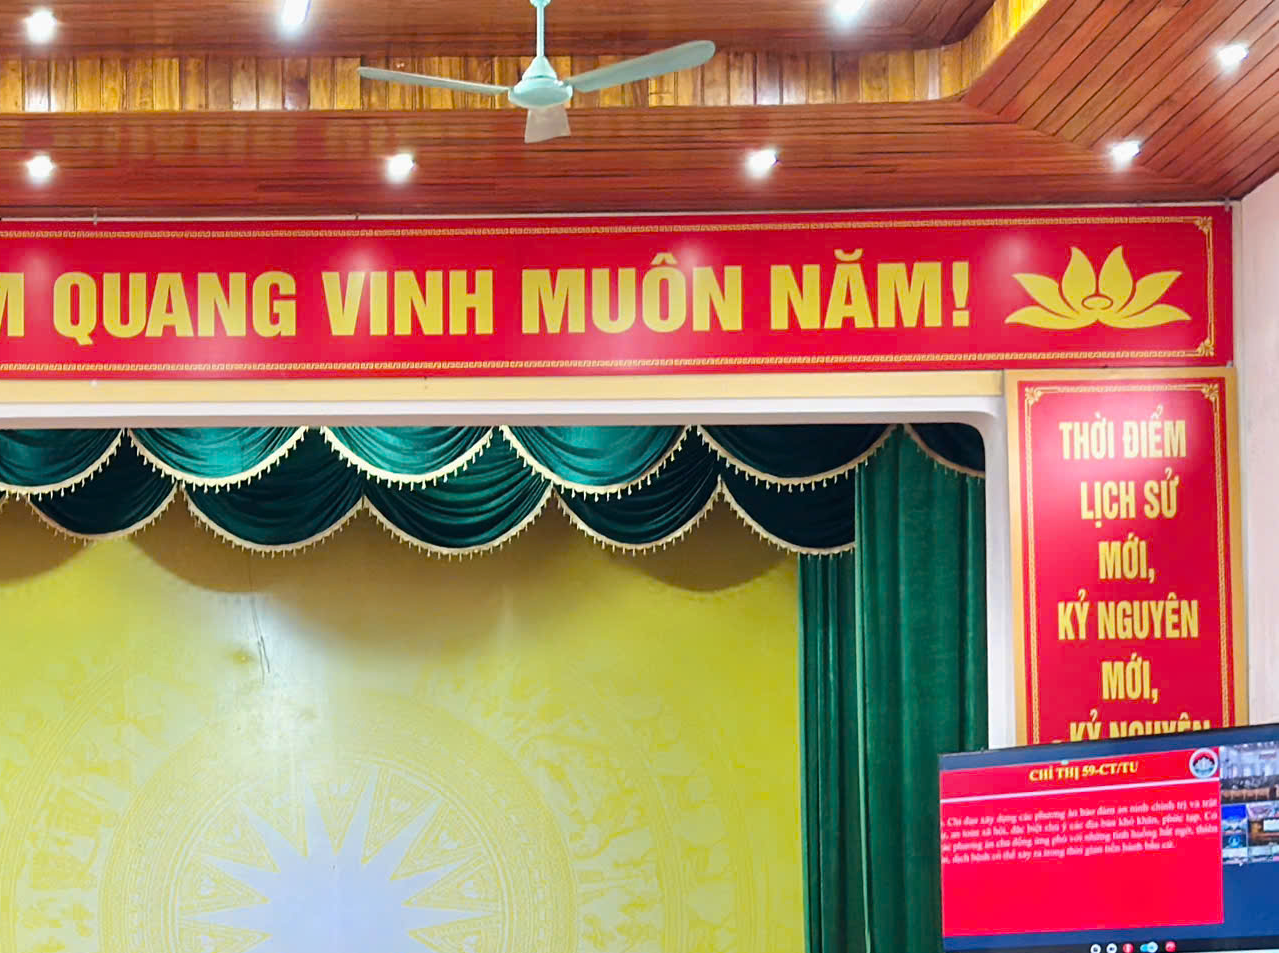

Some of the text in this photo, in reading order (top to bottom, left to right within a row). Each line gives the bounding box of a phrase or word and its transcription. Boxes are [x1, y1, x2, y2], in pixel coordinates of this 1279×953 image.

[52, 271, 297, 346] QUANG
[322, 269, 494, 336] VINH
[521, 253, 743, 334] MUÔN
[770, 248, 972, 331] NĂM!
[1058, 405, 1187, 460] THỜI ĐIỂM
[1080, 467, 1179, 529] LỊCH SỬ
[1098, 532, 1155, 584] MỚI,
[1057, 589, 1200, 641] KỶ NGUYÊN
[1101, 652, 1159, 704] MỚI,
